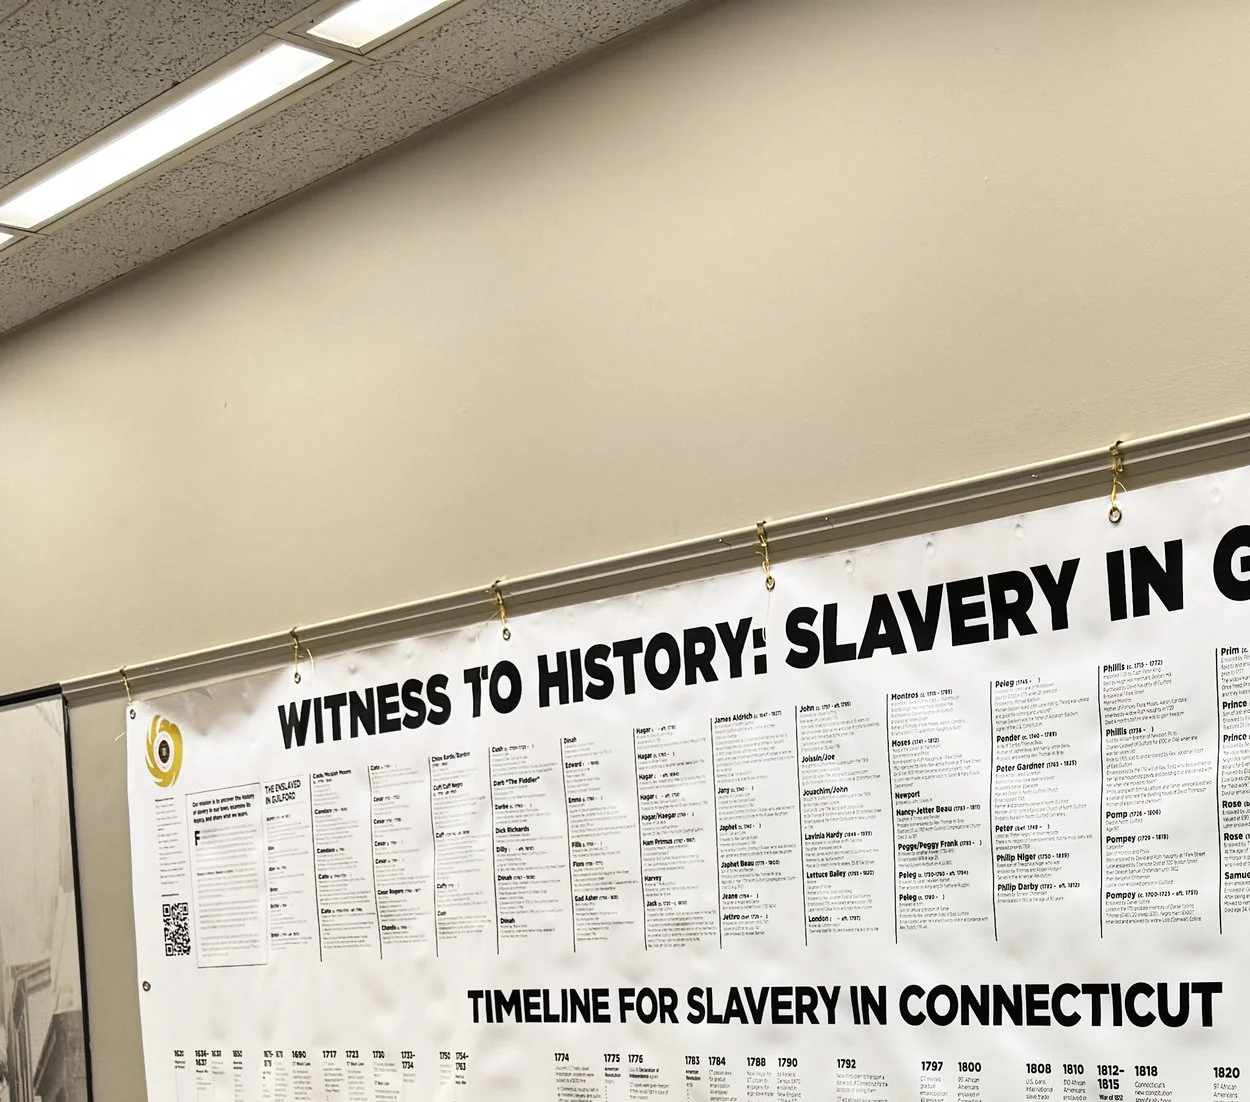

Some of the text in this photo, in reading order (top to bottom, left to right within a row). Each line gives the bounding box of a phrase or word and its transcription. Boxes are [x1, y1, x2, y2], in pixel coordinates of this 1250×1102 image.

[277, 673, 452, 750] WITNESS
[463, 660, 523, 718] TO
[537, 616, 768, 708] HISTORY:
[784, 558, 1080, 670] SLAVERY
[1105, 538, 1184, 621] IN
[467, 982, 1223, 1028] TIMELINE FOR SLAVERY IN CONNECTICUT
[292, 1050, 306, 1058] 1690
[322, 1050, 337, 1058] 1717
[345, 1050, 359, 1058] 1723
[554, 1053, 569, 1062] 1774
[604, 1053, 620, 1063] 1775
[628, 1054, 643, 1063] 1776
[685, 1056, 700, 1065] 1783
[708, 1056, 726, 1066] 1784
[747, 1057, 766, 1067] 1788
[778, 1058, 798, 1067] 1790
[837, 1059, 856, 1069] 1792
[921, 1061, 943, 1071] 1797
[958, 1062, 982, 1072] 1800
[1026, 1063, 1051, 1074] 1808
[1063, 1064, 1084, 1075] 1810
[1134, 1065, 1158, 1077] 1818
[1213, 1067, 1240, 1078] 1820
[1097, 1078, 1119, 1090] 1815
